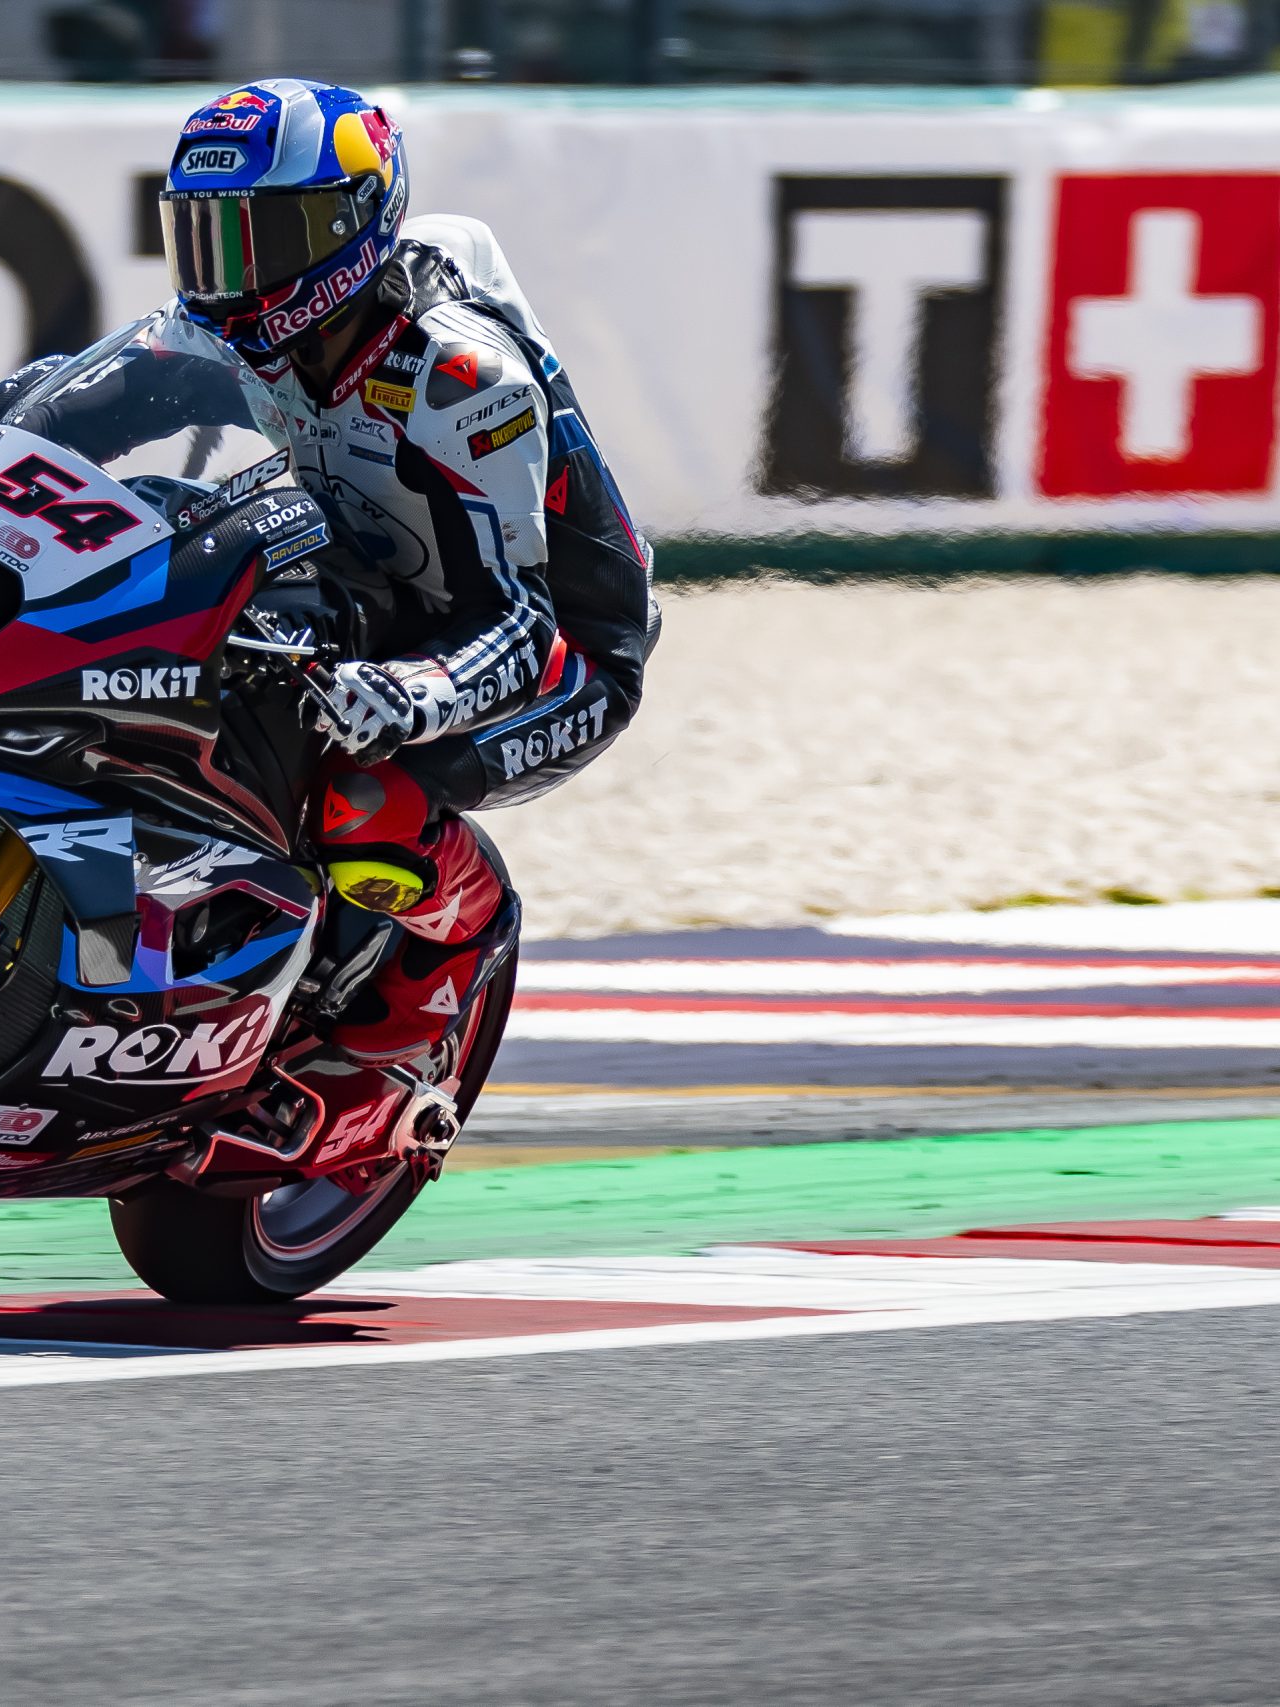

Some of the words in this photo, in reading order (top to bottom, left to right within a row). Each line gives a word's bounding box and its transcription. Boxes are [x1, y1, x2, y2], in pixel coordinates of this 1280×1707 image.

[219, 112, 262, 131] Bull
[185, 149, 237, 171] SHOEI
[218, 189, 256, 198] WINGS
[383, 184, 406, 229] SHOEI
[188, 290, 243, 301] PROMETEON
[261, 282, 332, 345] Red
[328, 237, 380, 304] Bull
[370, 384, 412, 409] PIRELLI
[456, 383, 533, 432] DAINESE
[232, 450, 288, 498] WRS
[198, 494, 228, 520] Racing
[254, 502, 307, 535] EDOX
[271, 533, 322, 562] RAVENOL
[314, 1090, 402, 1166] 54
